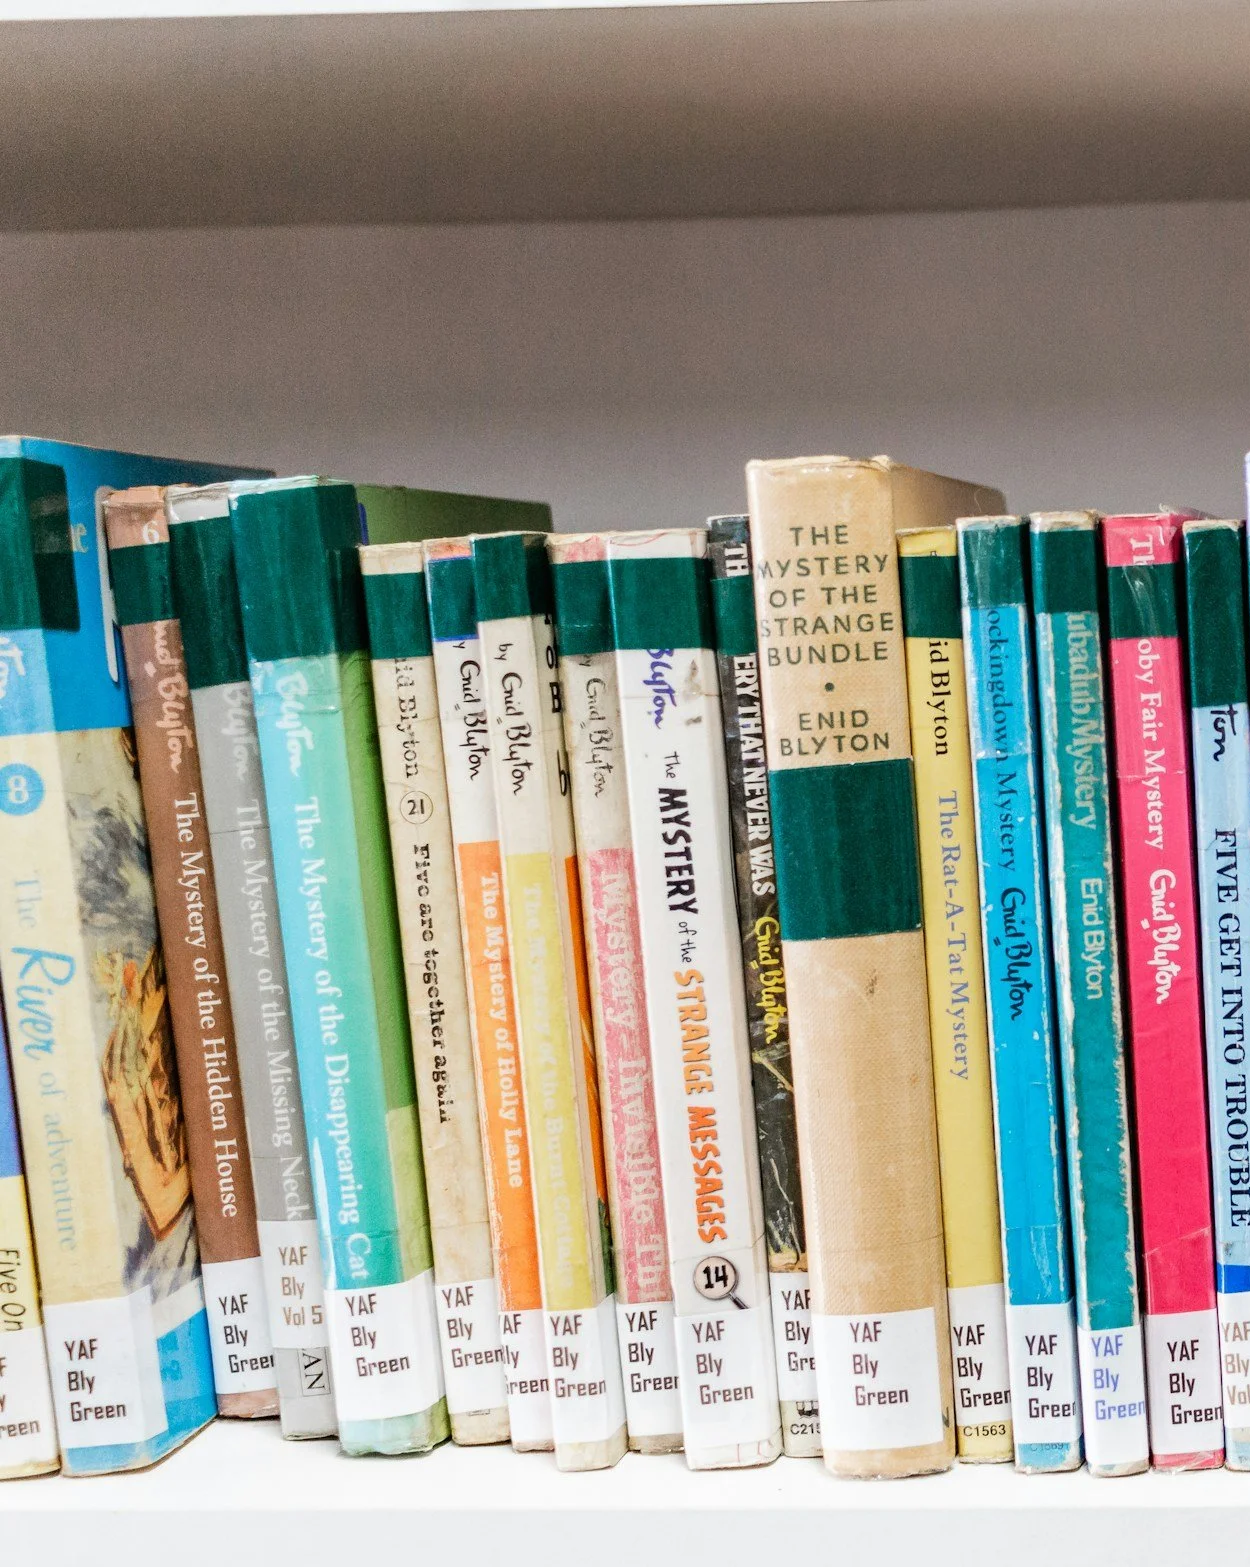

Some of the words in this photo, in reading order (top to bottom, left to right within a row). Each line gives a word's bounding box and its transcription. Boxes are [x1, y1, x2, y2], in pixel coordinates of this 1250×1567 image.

[790, 525, 849, 546] THE
[757, 554, 889, 581] MYSTERY
[769, 588, 806, 609] OF
[820, 584, 877, 605] THE
[760, 612, 894, 638] STRANGE
[767, 641, 888, 667] BUNDLE
[274, 671, 315, 777] Blyton
[396, 695, 420, 778] Blyton
[799, 709, 869, 731] ENID
[926, 668, 951, 756] Blyton
[1140, 691, 1161, 741] Fair
[458, 709, 489, 781] Blyton
[502, 722, 533, 796] Blyton
[780, 732, 890, 756] BLYTON
[1065, 716, 1097, 830] Mystery
[173, 792, 200, 843] The
[236, 799, 260, 850] The
[294, 796, 323, 849] The
[743, 768, 770, 841] NEVER
[938, 790, 958, 839] The
[996, 771, 1017, 872] Mystery
[1142, 748, 1166, 850] Mystery
[658, 787, 699, 915] MYSTERY
[749, 843, 776, 896] WAS
[1214, 828, 1237, 903] FIVE
[177, 850, 207, 949] Mystery
[240, 858, 269, 966] Mystery
[298, 858, 328, 962] Mystery
[481, 871, 499, 919] The
[1081, 877, 1103, 929] Enid
[1081, 932, 1105, 999] Blyton
[1147, 920, 1183, 1004] Blyton
[1218, 914, 1243, 976] GET
[193, 957, 219, 985] of
[314, 969, 341, 1002] of
[482, 926, 508, 1028] Mystery
[1001, 940, 1033, 1022] Blyton
[11, 946, 77, 1062] River
[197, 988, 221, 1030] the
[260, 1003, 286, 1041] the
[422, 948, 448, 1048] together
[757, 965, 788, 1045] Blyton
[318, 1005, 345, 1043] the
[673, 968, 714, 1096] STRANGE
[946, 983, 970, 1081] Mystery
[1221, 987, 1246, 1066] INTO
[202, 1038, 233, 1132] Hidden
[266, 1048, 296, 1147] Missing
[496, 1054, 516, 1121] Holly
[323, 1054, 365, 1225] Disappearing
[505, 1130, 523, 1188] Lane
[214, 1138, 238, 1218] House
[687, 1105, 727, 1243] MESSAGES
[346, 1233, 372, 1279] Cat
[702, 1265, 729, 1289] 14
[283, 1307, 305, 1326] Vol
[344, 1294, 377, 1316] YAF
[441, 1286, 474, 1308] YAF
[626, 1311, 658, 1333] YAF
[64, 1338, 99, 1361] YAF
[692, 1320, 725, 1343] YAF
[850, 1321, 882, 1343] YAF
[953, 1325, 985, 1347] YAF
[1025, 1335, 1058, 1356] YAF
[1091, 1335, 1123, 1357] YAF
[1167, 1340, 1199, 1362] YAF
[71, 1402, 126, 1423] Green
[699, 1385, 754, 1405] Green
[855, 1385, 909, 1406] Green
[960, 1388, 1011, 1408] Green
[1171, 1405, 1223, 1425] Green
[963, 1424, 1006, 1437] C1563
